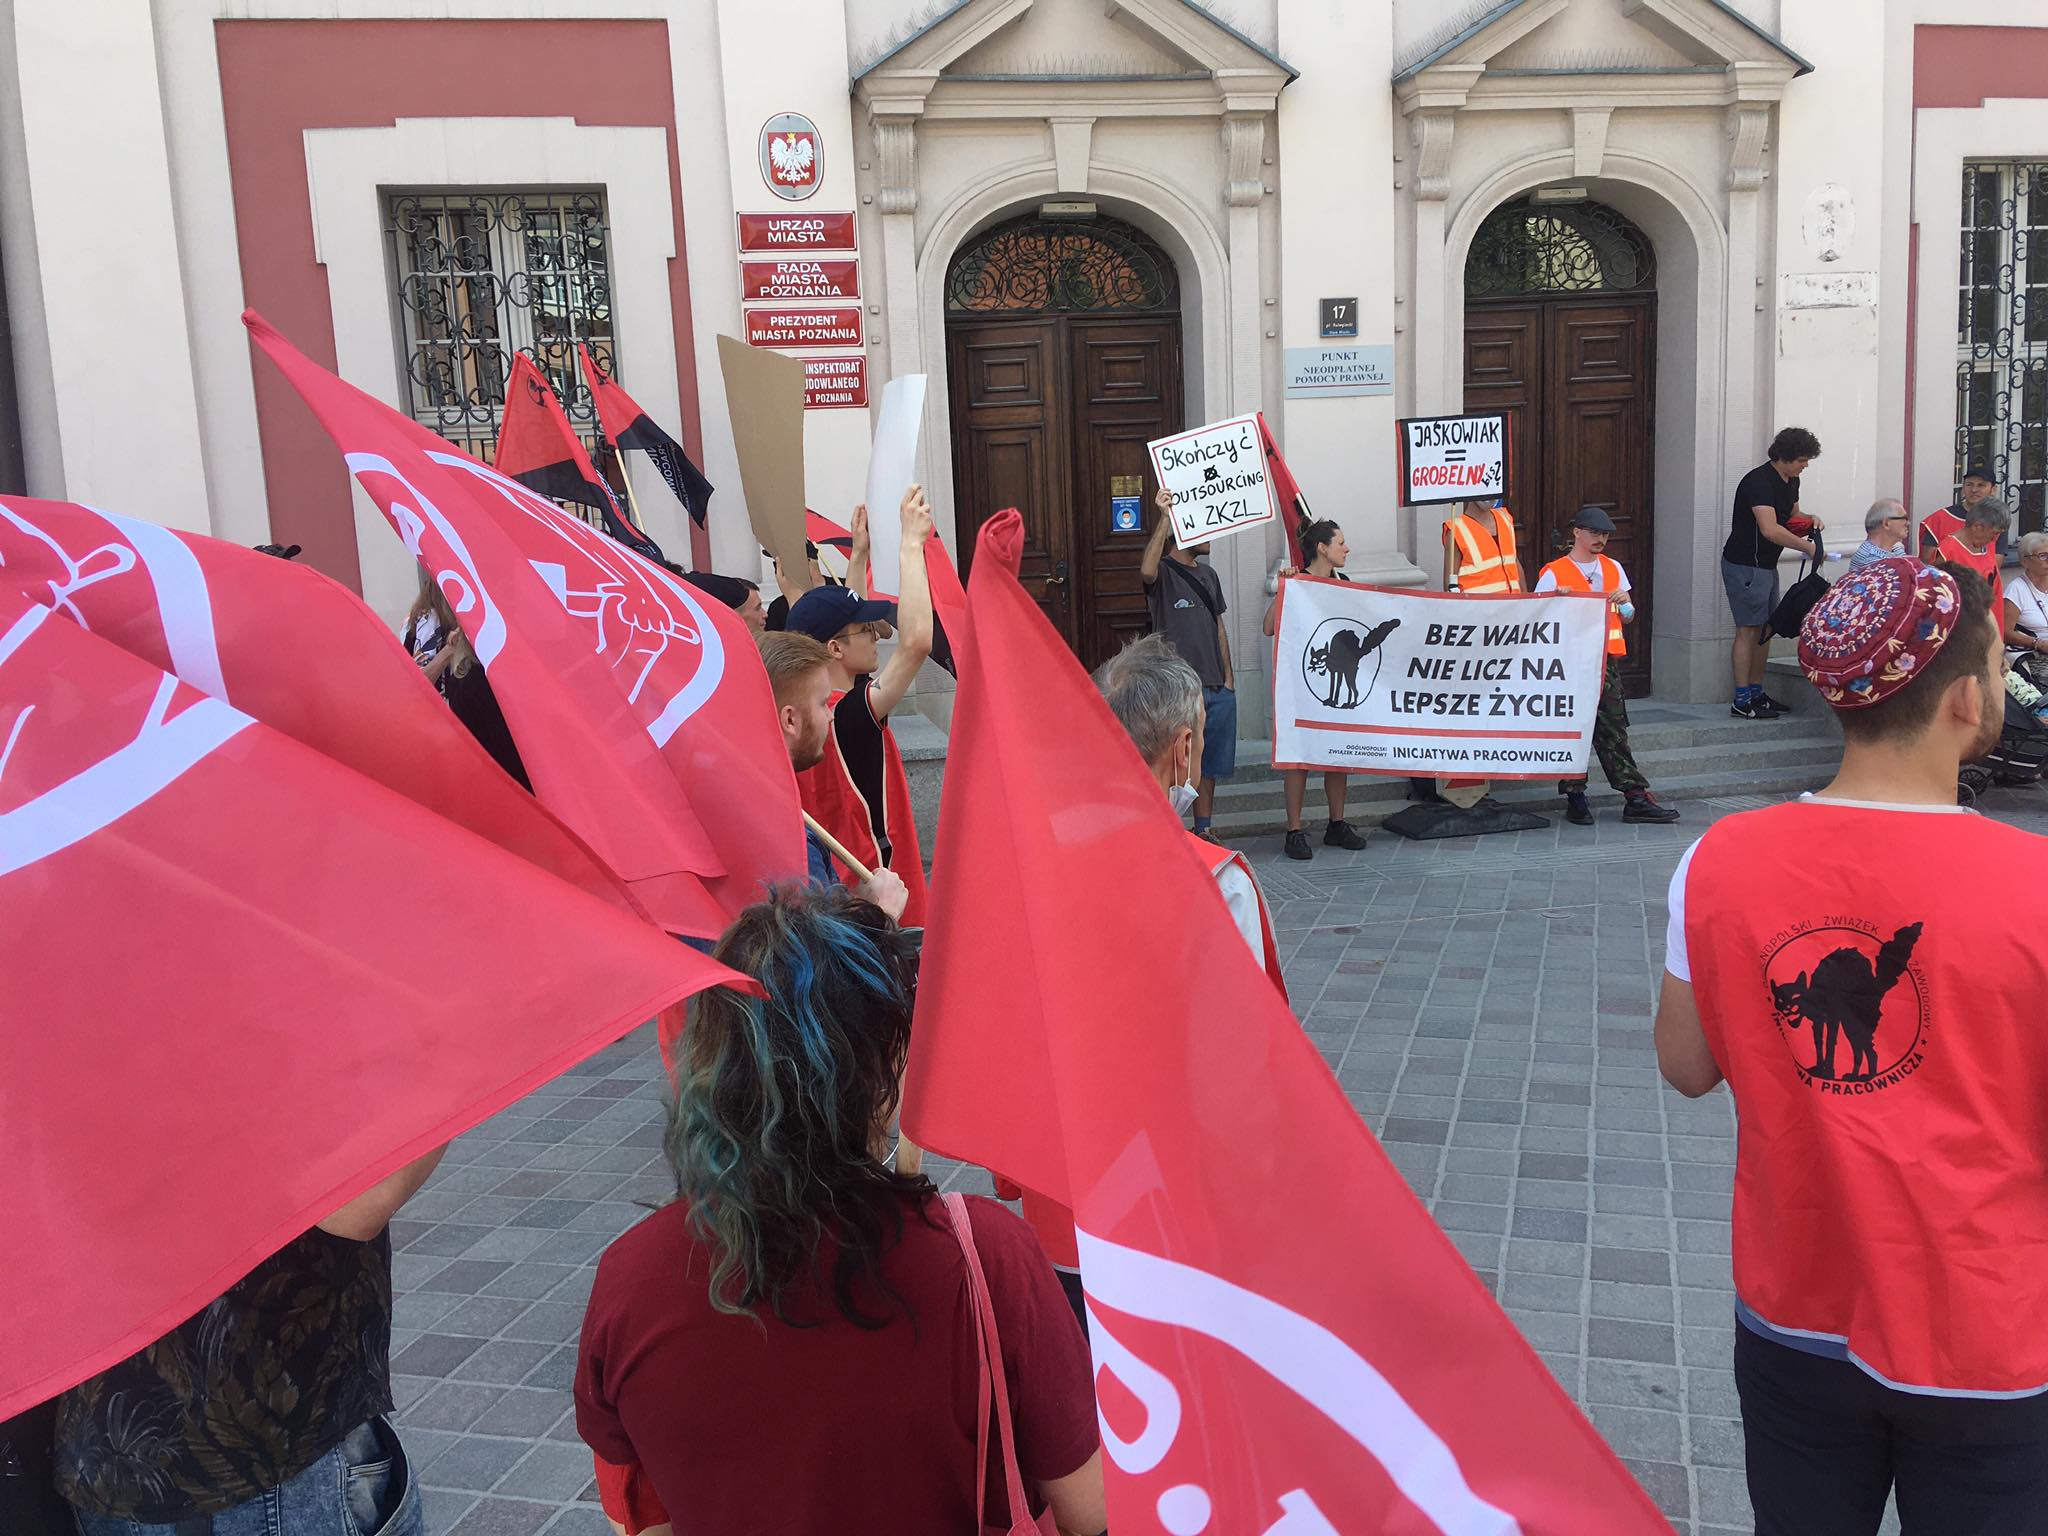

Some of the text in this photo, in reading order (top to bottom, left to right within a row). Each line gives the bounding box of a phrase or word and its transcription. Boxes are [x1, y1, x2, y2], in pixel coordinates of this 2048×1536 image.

[768, 219, 825, 231] URZĄD
[767, 231, 826, 243] MIASTA
[777, 262, 822, 273] RADA
[771, 274, 829, 285] MIASTA
[760, 285, 842, 297] POZNANIA
[1332, 305, 1346, 319] 17
[770, 315, 837, 327] PREZYDENT
[752, 328, 857, 341] MIASTA POZNANIA
[1321, 352, 1359, 361] PUNKT
[805, 361, 860, 375] INSPEKTORAT
[1295, 372, 1384, 384] POMOCY PRAWNEJ
[815, 392, 853, 403] POZNANIA
[1414, 420, 1500, 448] JAŚKOWIAK
[1412, 463, 1486, 487] GROBELNY
[1424, 622, 1560, 647] BEZ WALKI
[1406, 657, 1566, 681] NIE LICZ NA
[1390, 686, 1575, 718] LEPSZE ŻYCIE!
[1393, 746, 1574, 762] INICJATYWA PRACOWNICZA
[1821, 1052, 1924, 1095] PRACOWNICZA
